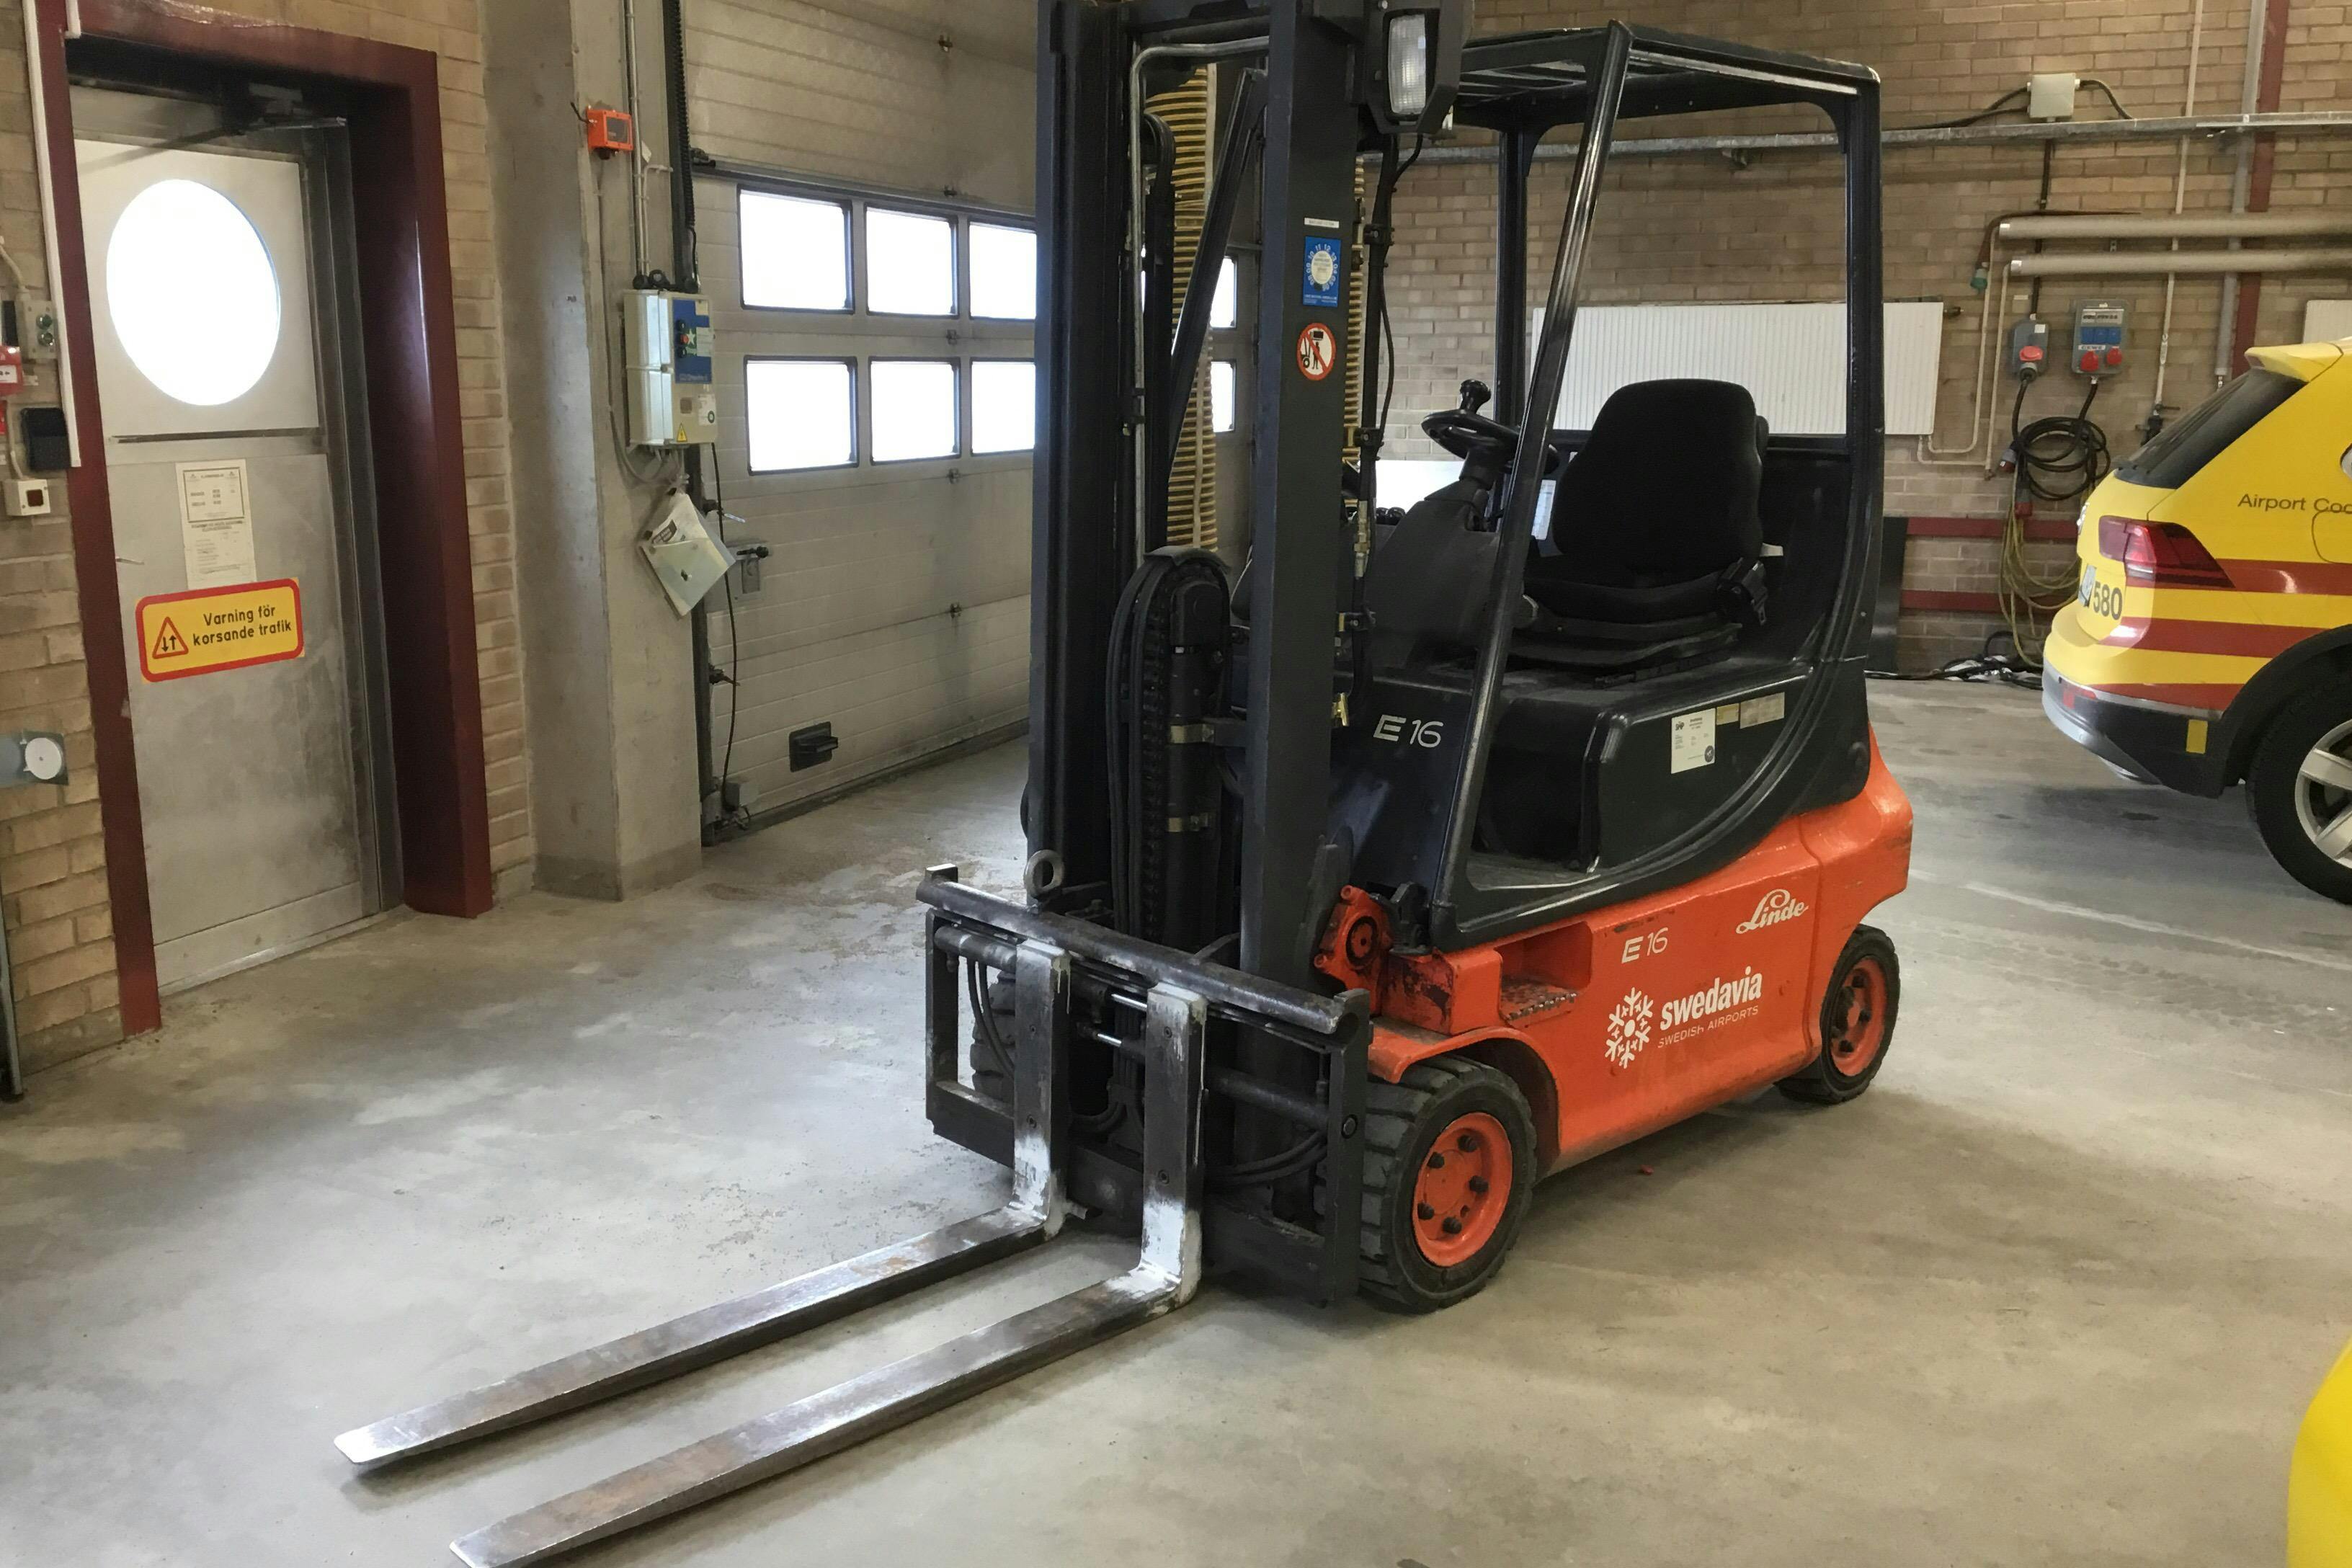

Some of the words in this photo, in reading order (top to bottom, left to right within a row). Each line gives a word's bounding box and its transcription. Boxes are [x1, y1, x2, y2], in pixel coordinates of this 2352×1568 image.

[2237, 493, 2306, 512] Airport
[2093, 582, 2122, 620] 580
[203, 609, 254, 626] Varning
[258, 605, 275, 618] för
[193, 625, 254, 646] korsande
[259, 620, 292, 636] trafik
[1736, 888, 1809, 935] Linde
[1660, 966, 1763, 1030] swedavia
[1707, 1005, 1759, 1031] AIRPORTS
